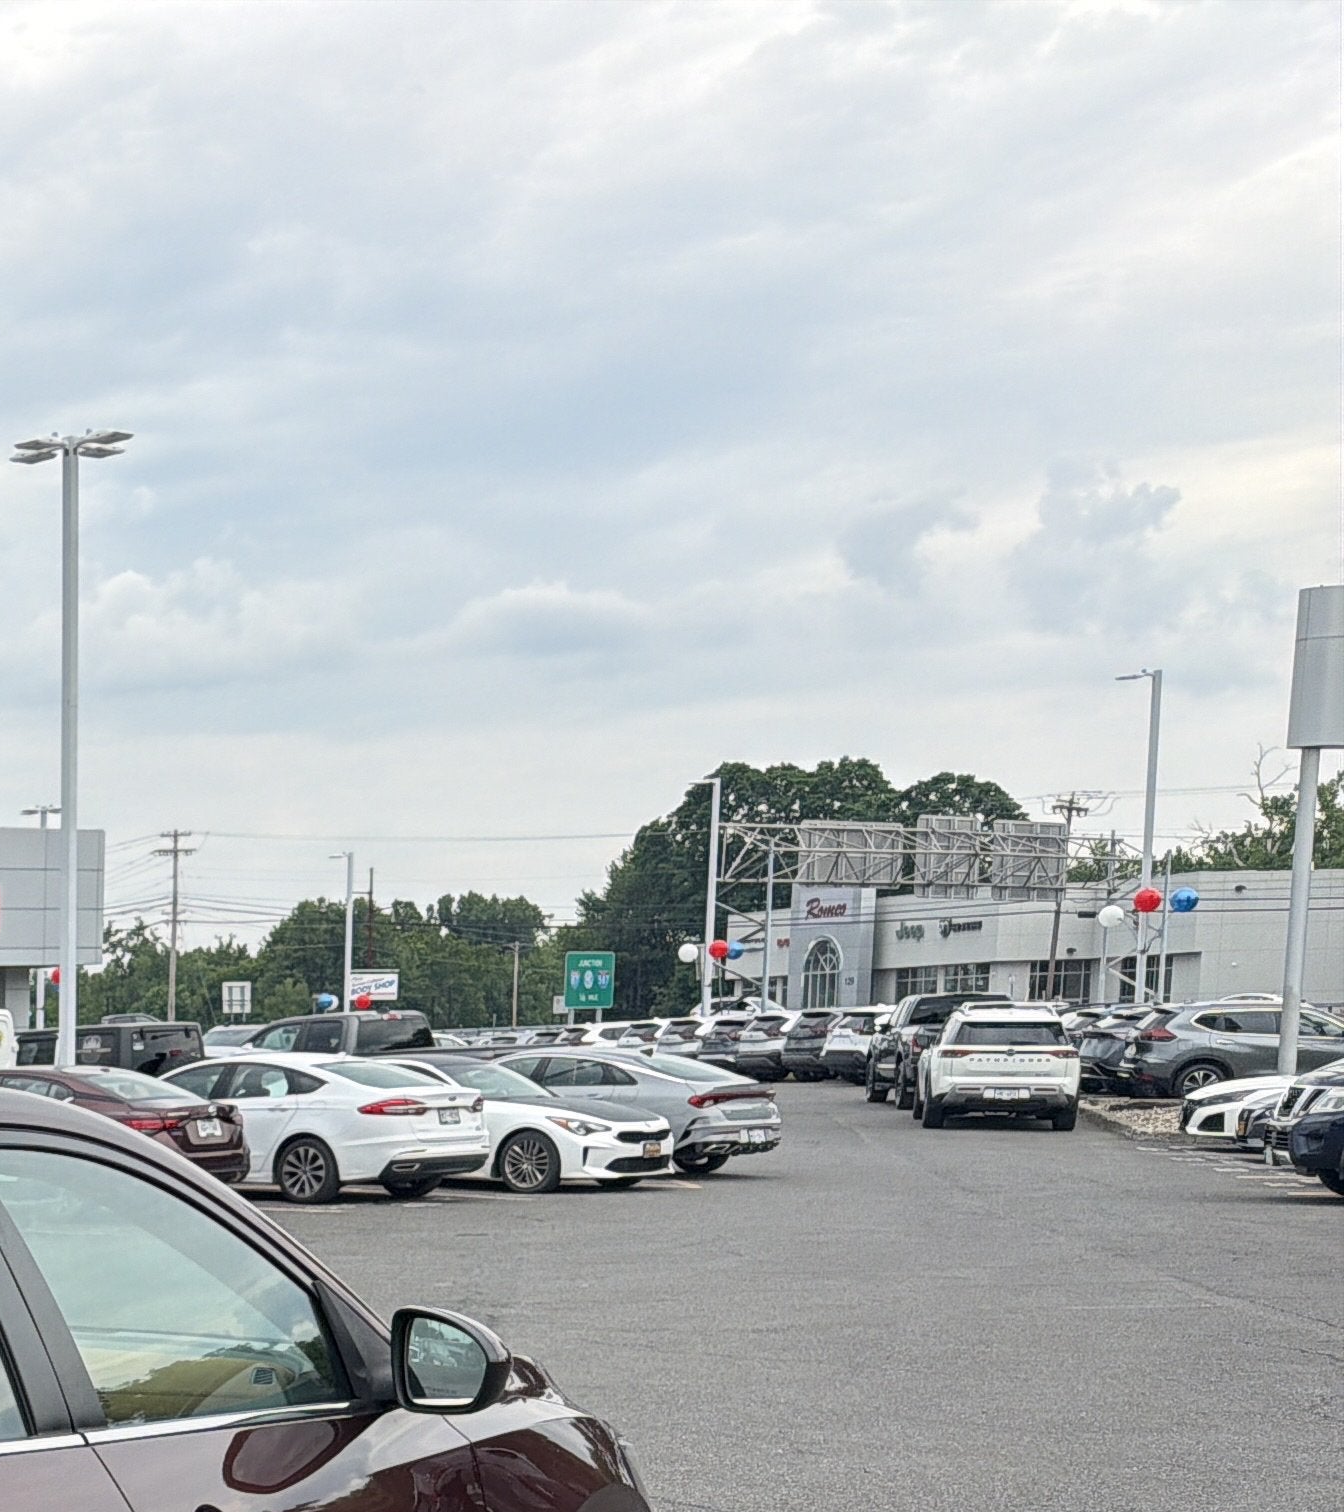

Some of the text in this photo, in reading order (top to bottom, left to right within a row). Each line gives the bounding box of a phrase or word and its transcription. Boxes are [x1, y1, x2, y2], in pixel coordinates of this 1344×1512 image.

[805, 897, 848, 920] Romeo
[895, 921, 925, 942] Jeep
[374, 979, 396, 990] SHOP
